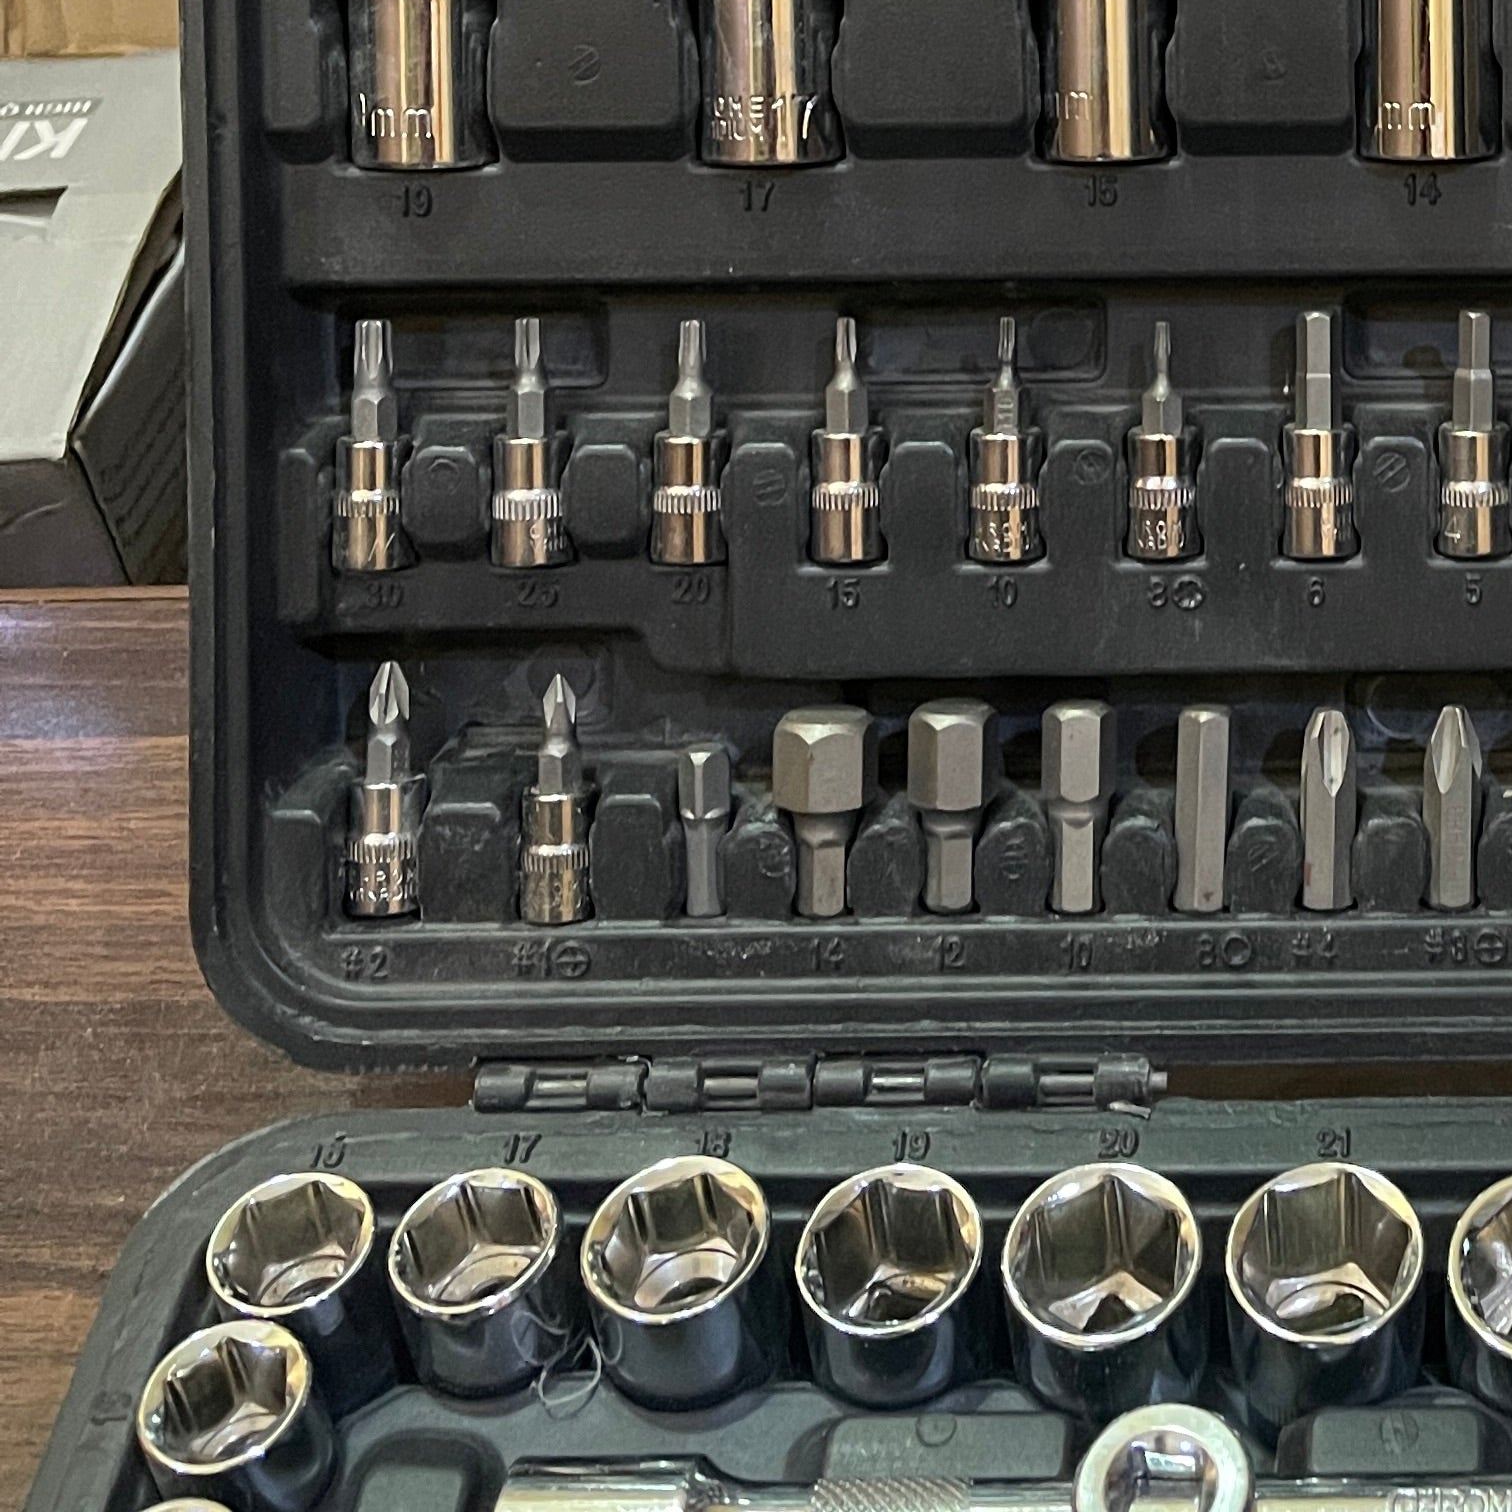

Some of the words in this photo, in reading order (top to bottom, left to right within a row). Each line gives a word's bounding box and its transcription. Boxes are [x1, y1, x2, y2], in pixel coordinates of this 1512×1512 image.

[400, 184, 433, 218] 19
[740, 179, 776, 213] 17
[1404, 173, 1442, 207] 14
[1464, 572, 1483, 605] 5
[936, 934, 966, 971] 12
[503, 1132, 543, 1165] 17
[893, 1128, 932, 1163] 19
[1098, 1126, 1141, 1159] 20
[1316, 1126, 1352, 1159] 21
